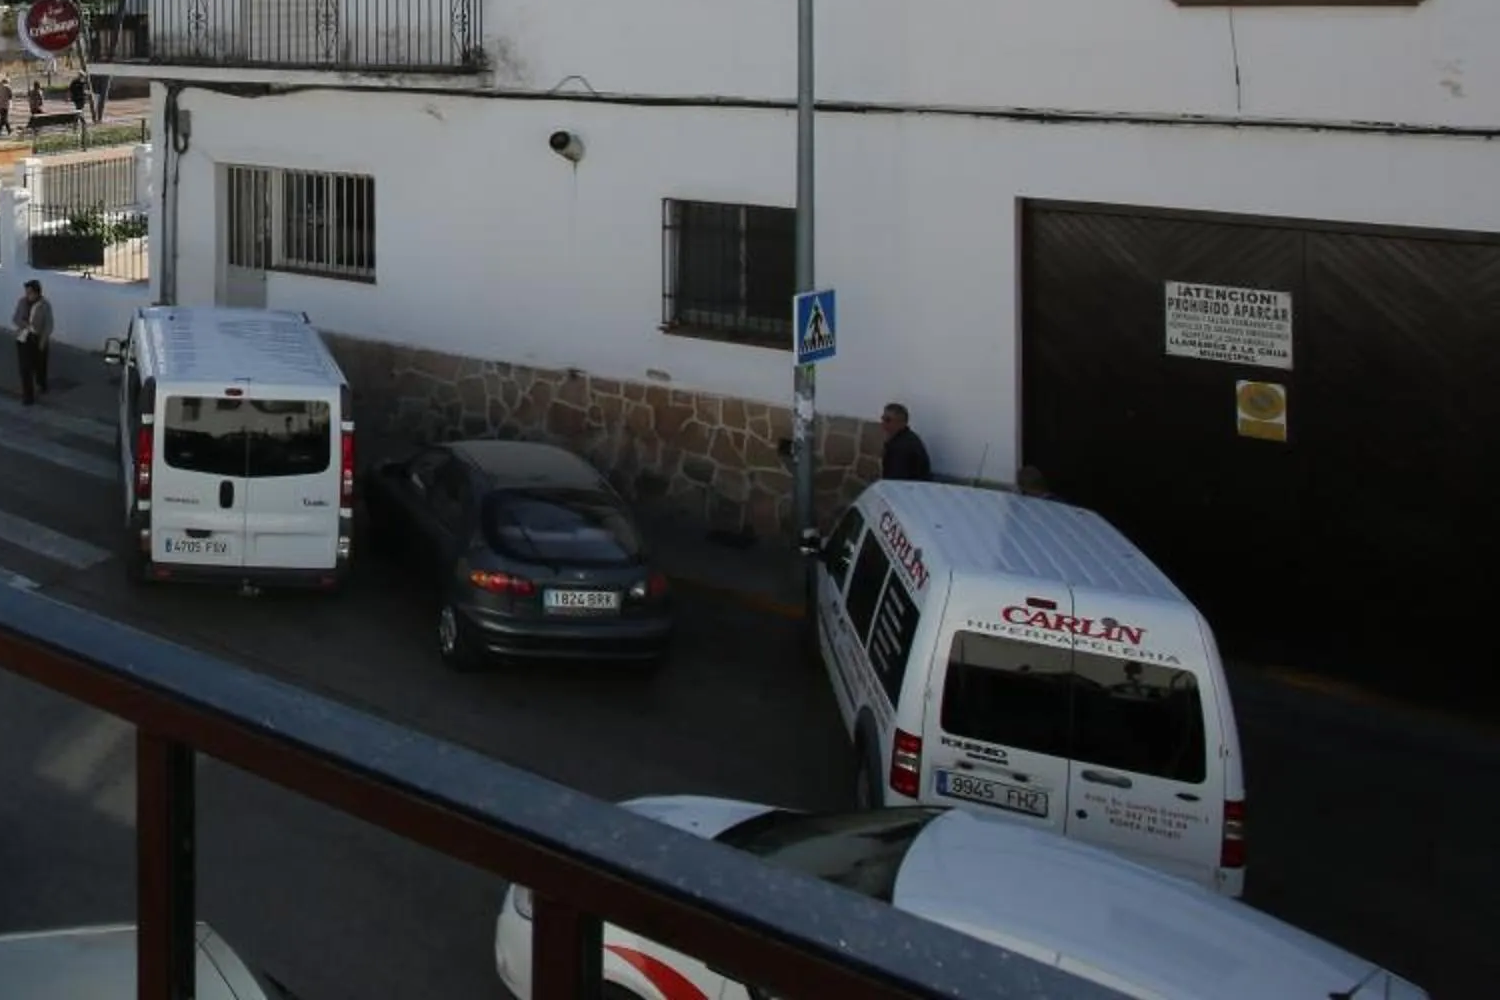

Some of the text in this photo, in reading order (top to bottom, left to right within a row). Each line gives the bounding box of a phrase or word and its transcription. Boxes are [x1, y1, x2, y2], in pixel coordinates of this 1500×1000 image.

[1167, 297, 1229, 316] PROHIBIDO
[1234, 304, 1288, 321] APARCAR
[966, 618, 1182, 665] HIPERPAPELERIA
[952, 777, 1039, 810] 9945 FHZ
